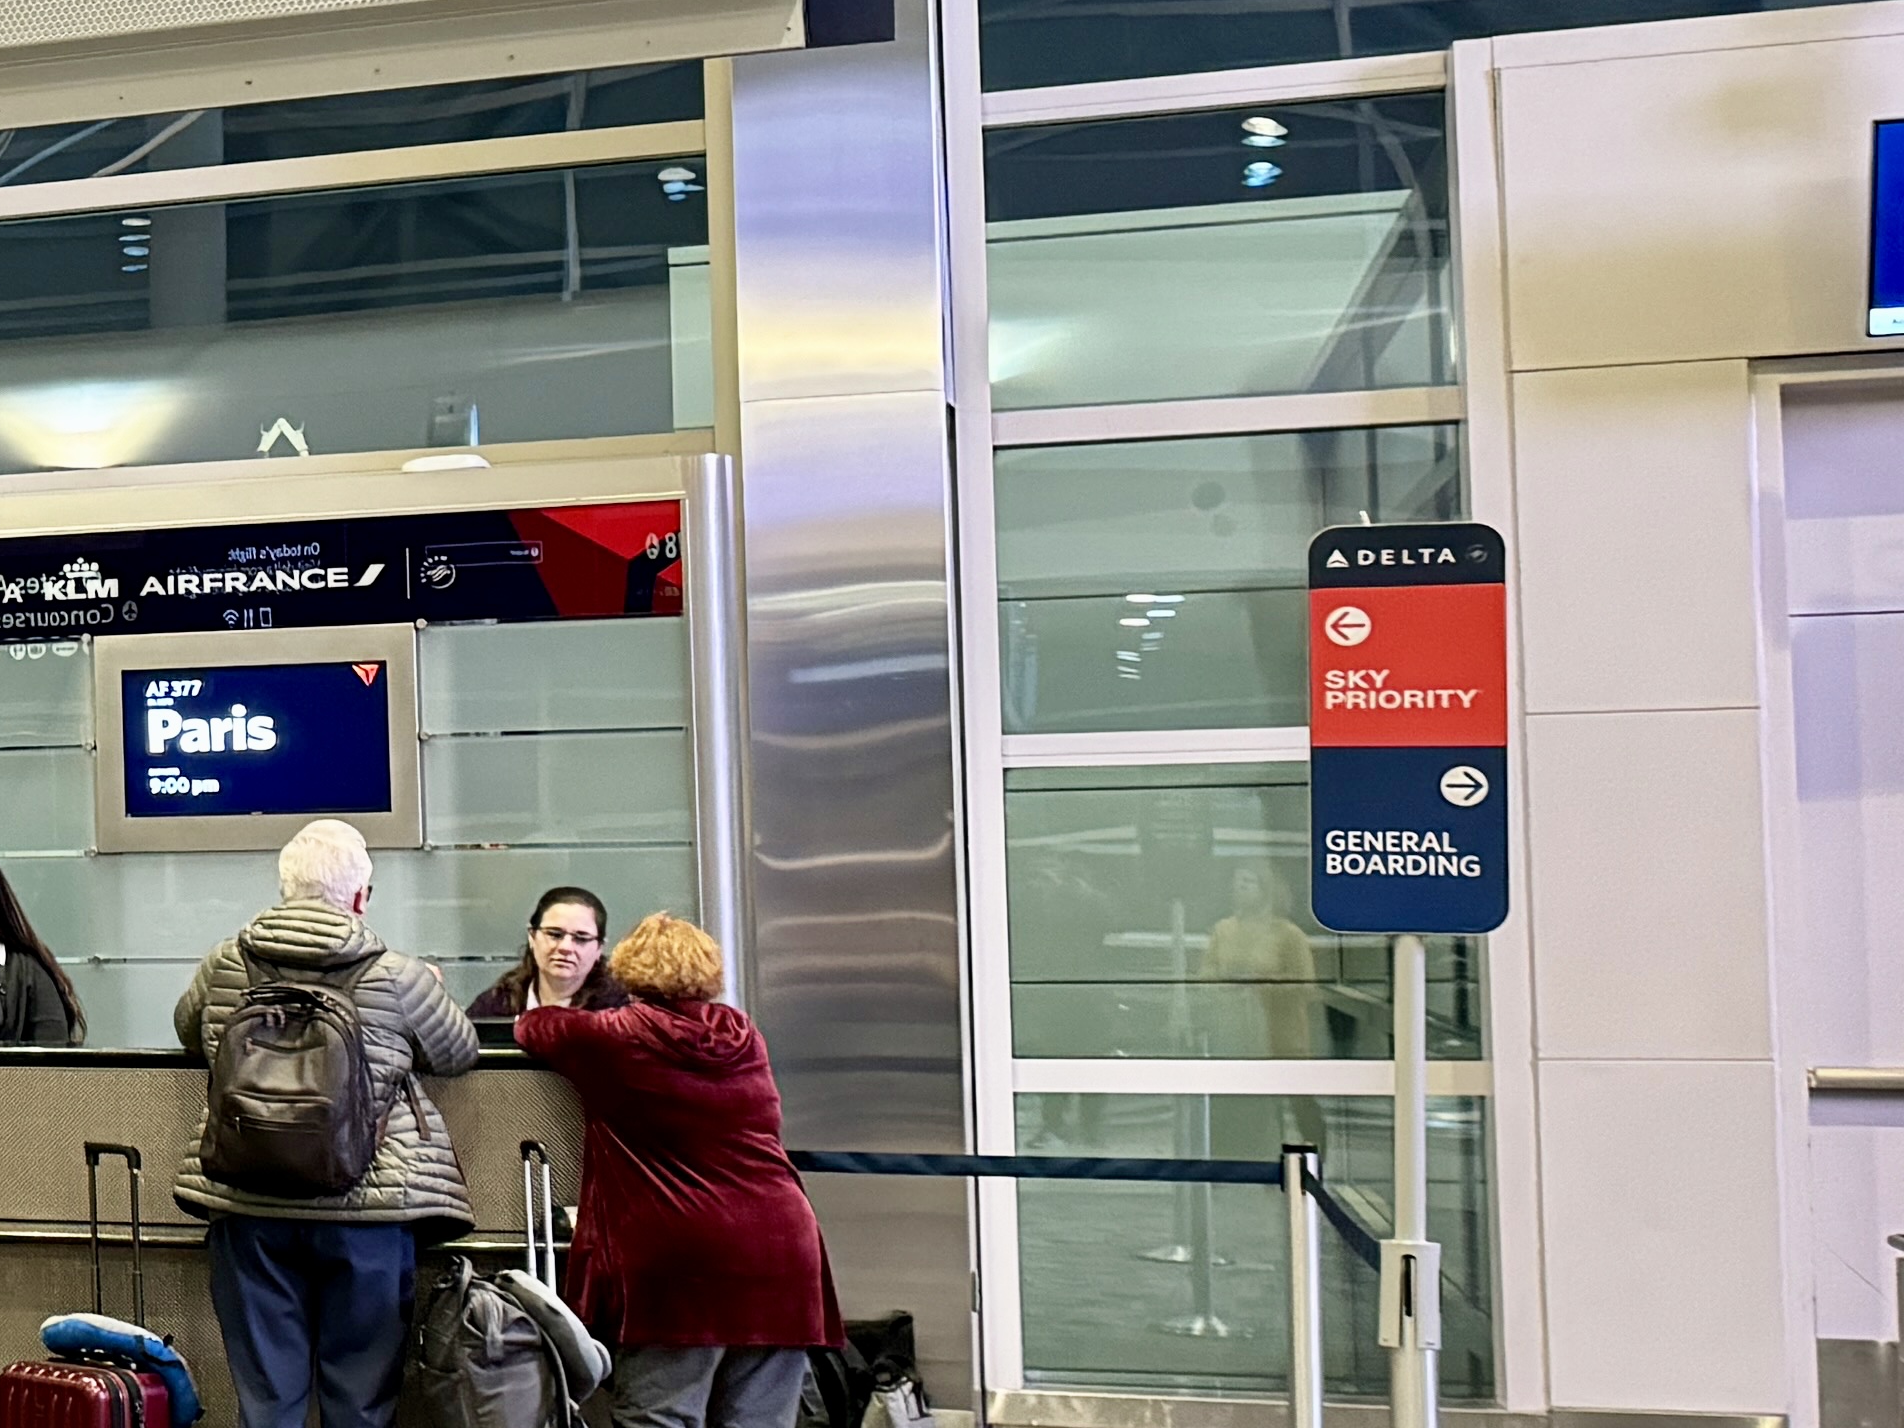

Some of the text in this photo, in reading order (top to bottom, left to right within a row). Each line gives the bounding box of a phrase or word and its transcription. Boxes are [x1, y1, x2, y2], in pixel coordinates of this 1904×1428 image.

[1356, 548, 1457, 566] DELTA
[44, 578, 119, 601] KLM
[139, 567, 349, 597] AIRFRANCE
[145, 679, 203, 698] AF 377
[1324, 668, 1390, 690] SKY
[1325, 689, 1480, 710] PRIORITY
[147, 703, 278, 754] Paris
[148, 776, 220, 796] 9:00 pm
[1325, 830, 1458, 854] GENERAL
[1325, 854, 1481, 877] BOARDING
